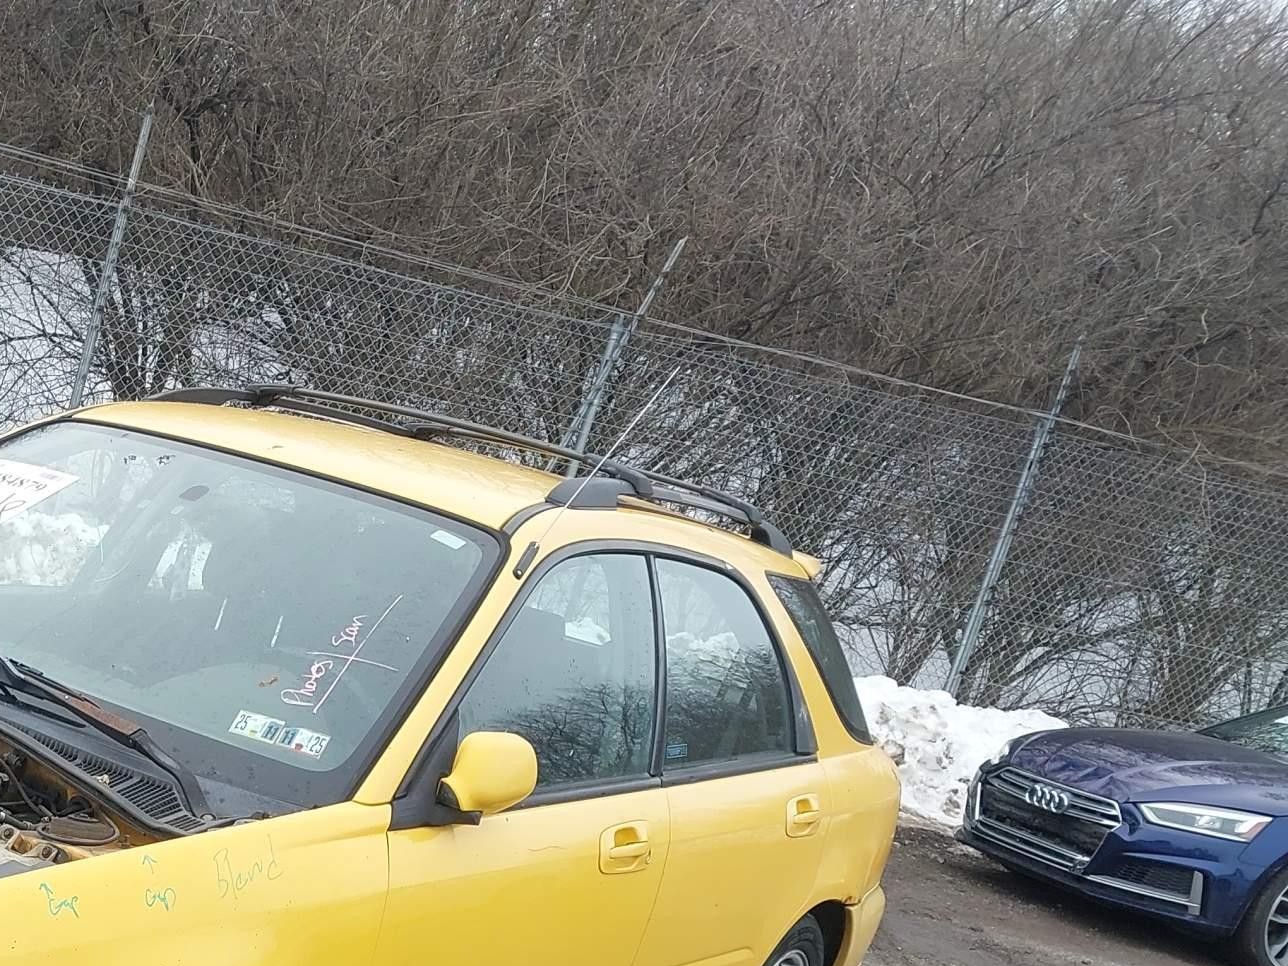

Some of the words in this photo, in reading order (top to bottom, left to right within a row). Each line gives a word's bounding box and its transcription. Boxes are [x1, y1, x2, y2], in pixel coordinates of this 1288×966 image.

[235, 714, 251, 730] 25
[309, 736, 326, 754] 25
[213, 834, 284, 899] Blend
